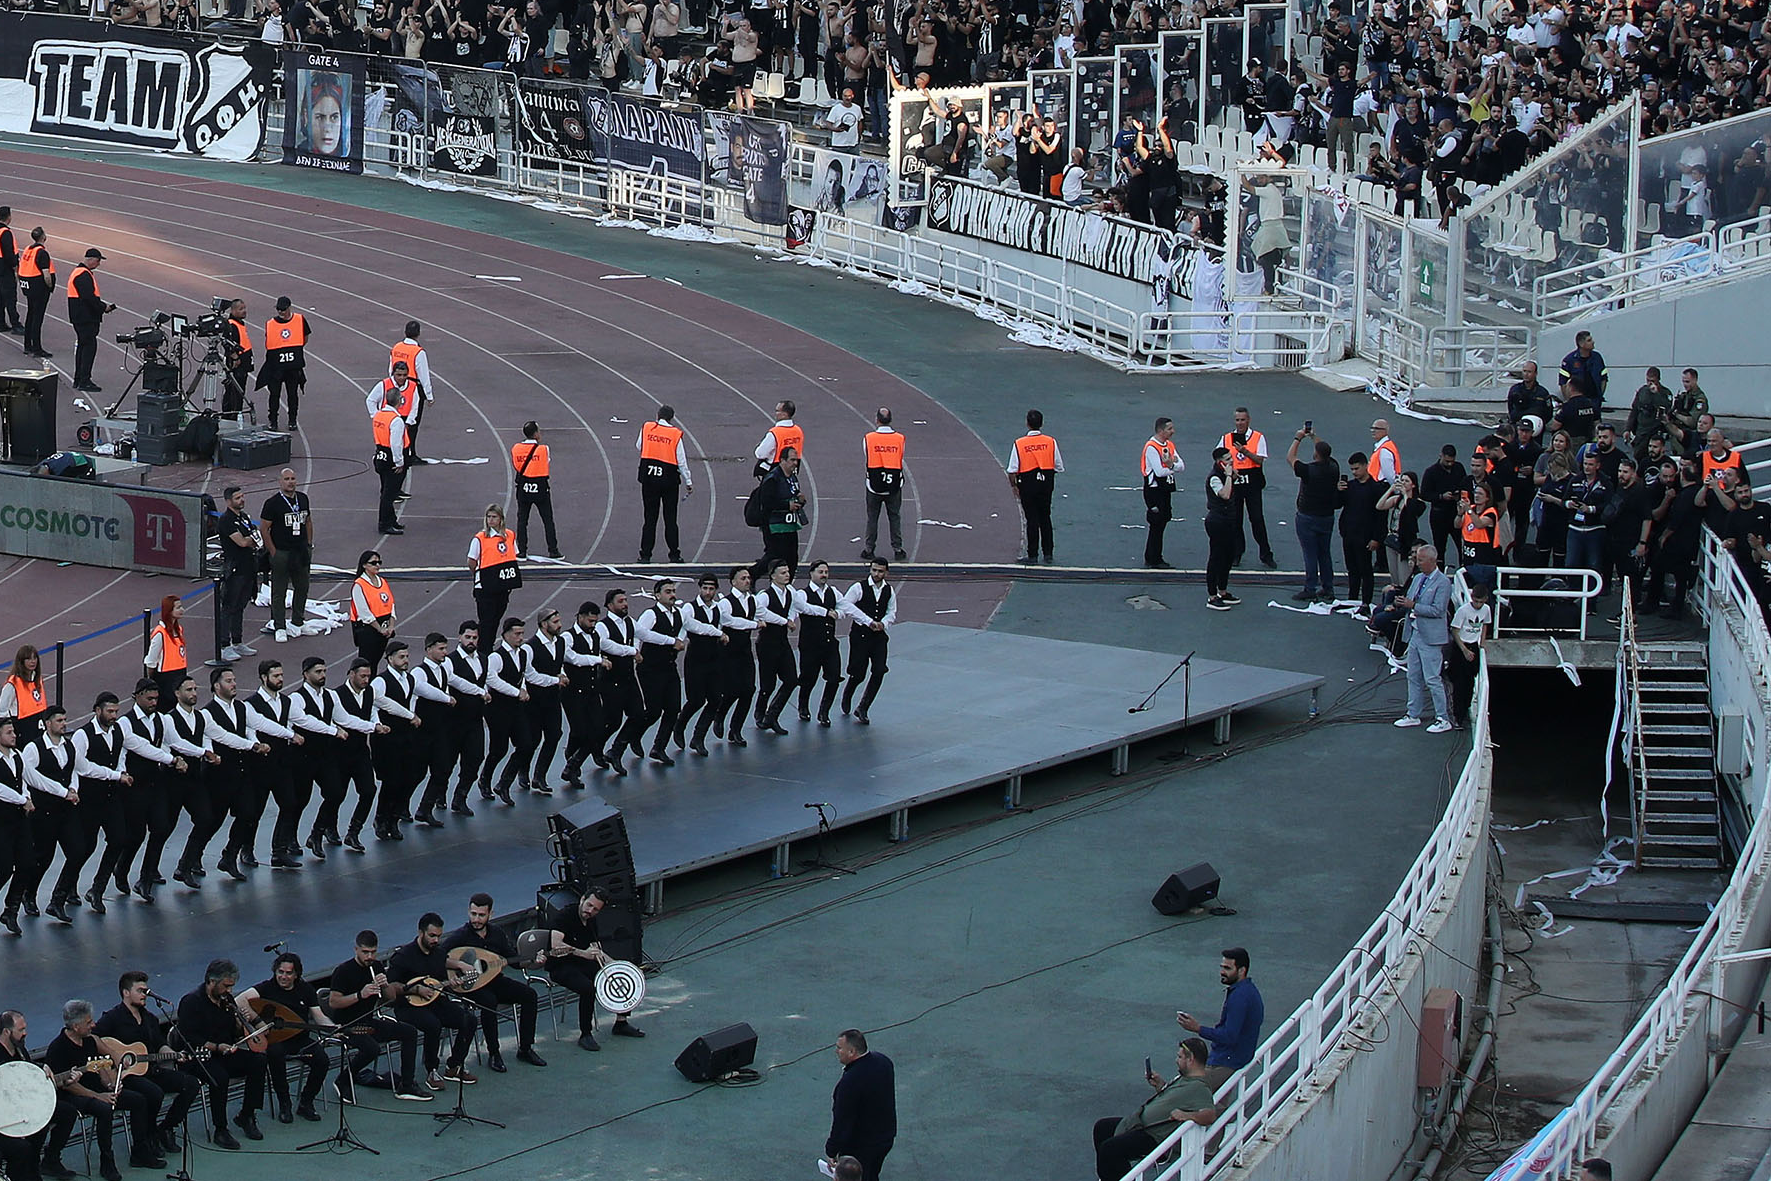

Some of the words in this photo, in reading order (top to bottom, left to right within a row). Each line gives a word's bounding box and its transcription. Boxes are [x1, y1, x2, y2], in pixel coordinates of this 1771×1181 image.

[308, 54, 332, 67] GATE
[333, 58, 340, 68] 4
[38, 50, 183, 133] TEAM
[1031, 210, 1045, 253] &
[279, 352, 294, 363] 215
[647, 434, 672, 445] SECURITY
[1024, 443, 1049, 453] SECURITY
[874, 450, 898, 459] SECURITY
[648, 466, 663, 478] 713
[523, 482, 538, 493] 422
[0, 503, 120, 543] COSMOTE
[499, 567, 516, 580] 428
